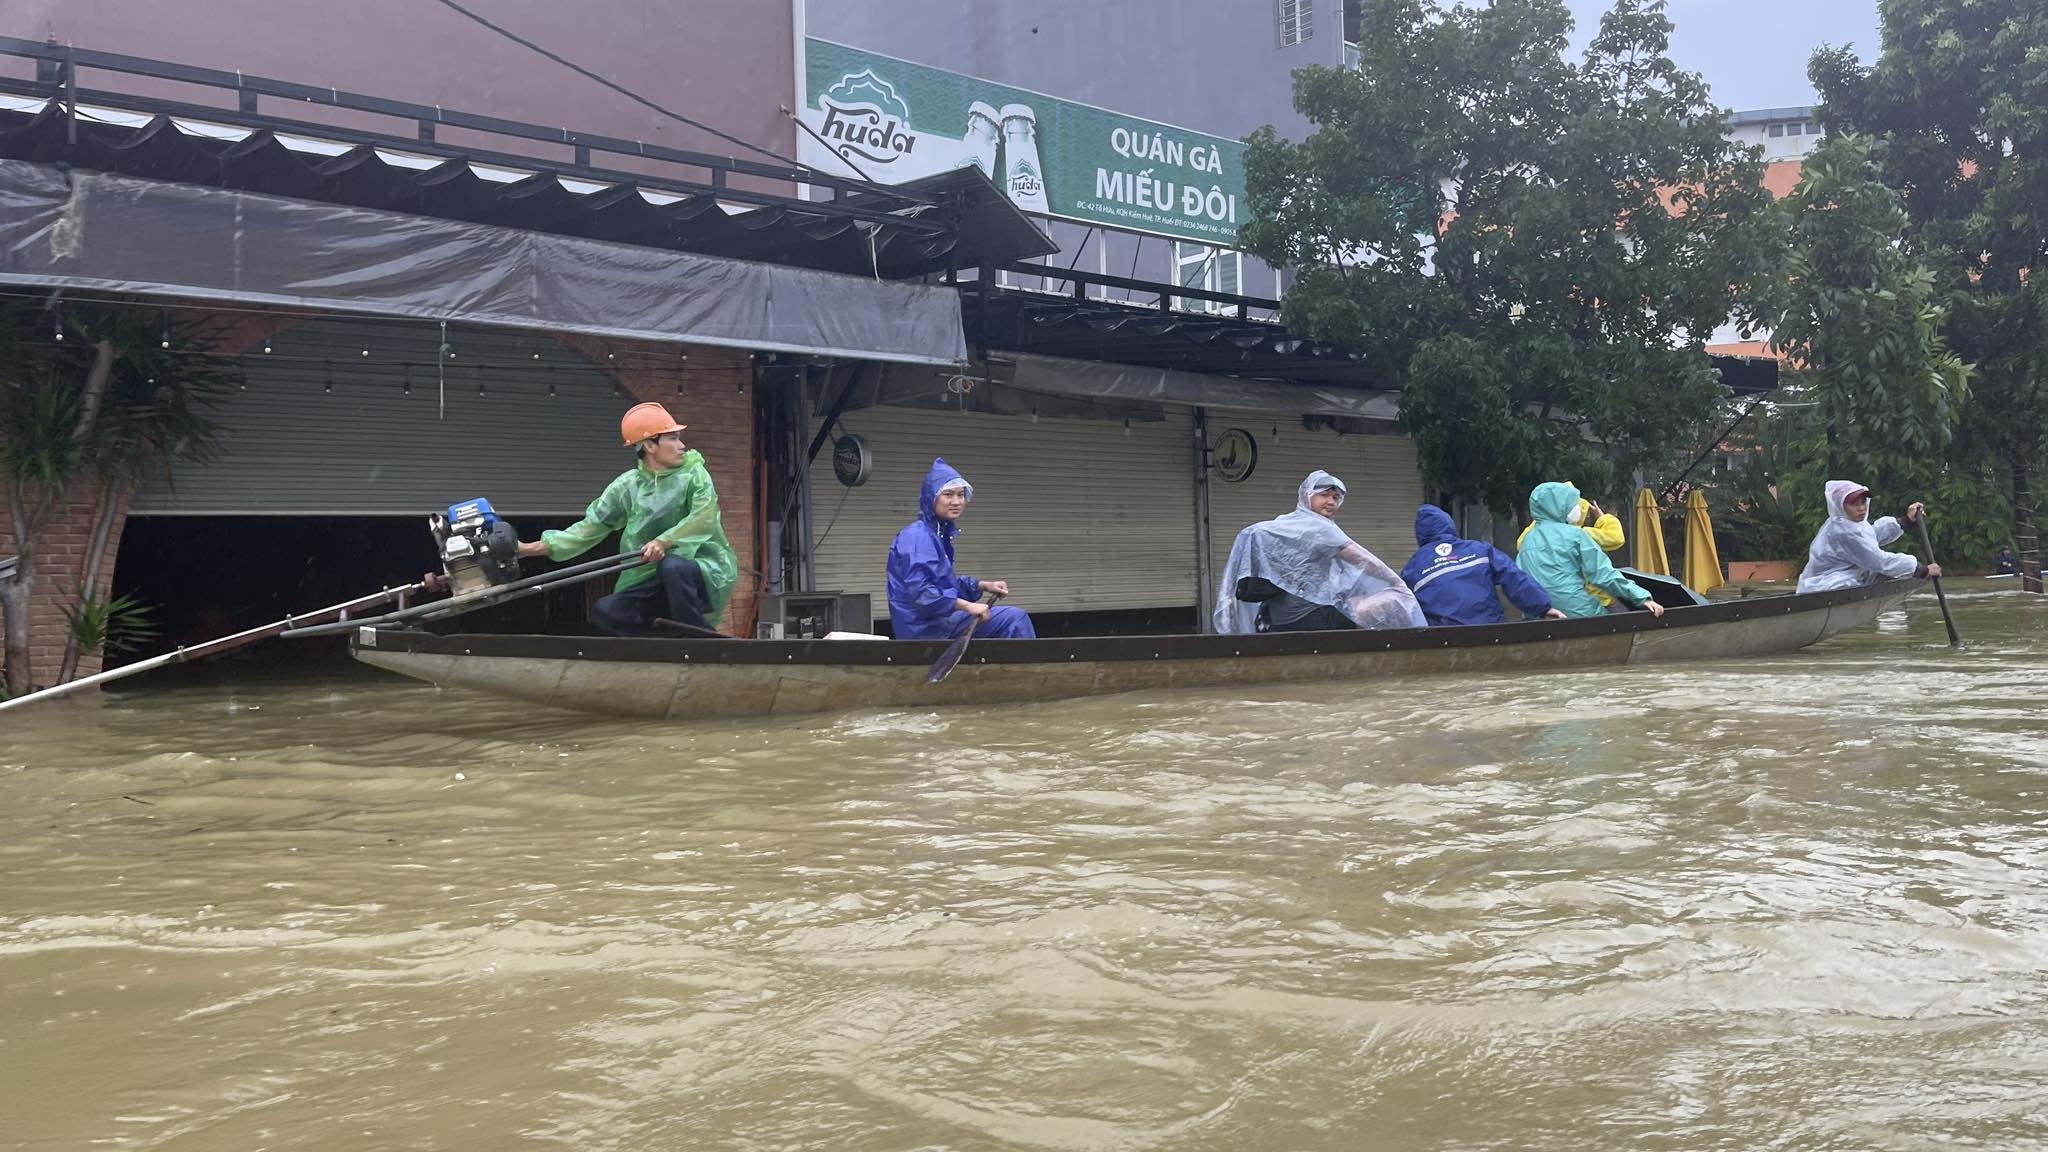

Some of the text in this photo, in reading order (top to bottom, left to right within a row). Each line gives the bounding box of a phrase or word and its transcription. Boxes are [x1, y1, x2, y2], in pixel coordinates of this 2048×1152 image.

[821, 101, 916, 155] huda
[1110, 127, 1223, 175] QUÁN GÀ
[1011, 175, 1041, 192] huda
[1095, 167, 1236, 224] MIẾU ĐÔI
